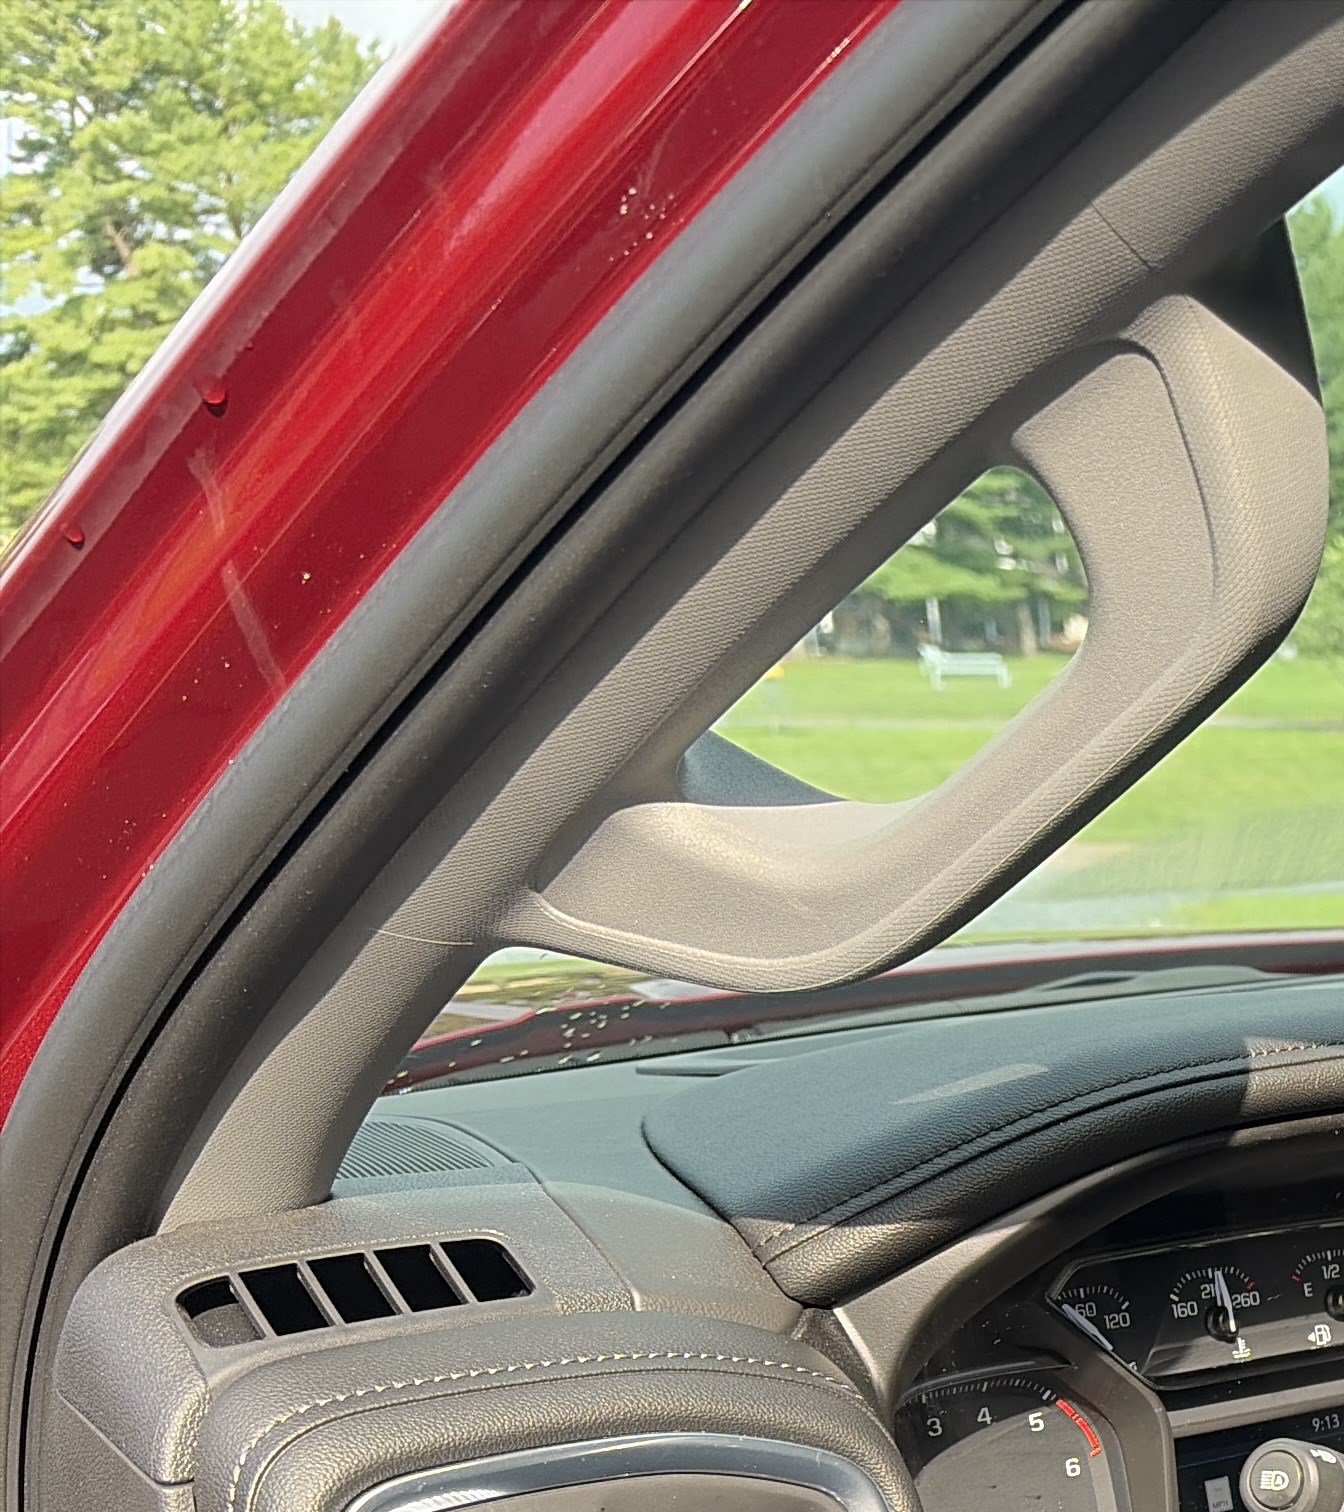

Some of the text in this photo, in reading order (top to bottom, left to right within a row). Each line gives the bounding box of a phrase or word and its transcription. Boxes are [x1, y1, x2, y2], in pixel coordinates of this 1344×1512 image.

[1321, 1263, 1341, 1279] 1/2
[1303, 1281, 1314, 1298] E
[1232, 1290, 1260, 1309] 260
[1171, 1301, 1198, 1319] 160
[1103, 1311, 1131, 1330] 120
[977, 1406, 993, 1425] 4
[1028, 1412, 1045, 1432] 5
[1311, 1413, 1341, 1433] 9:13
[926, 1417, 943, 1437] 3
[1065, 1457, 1081, 1477] 6
